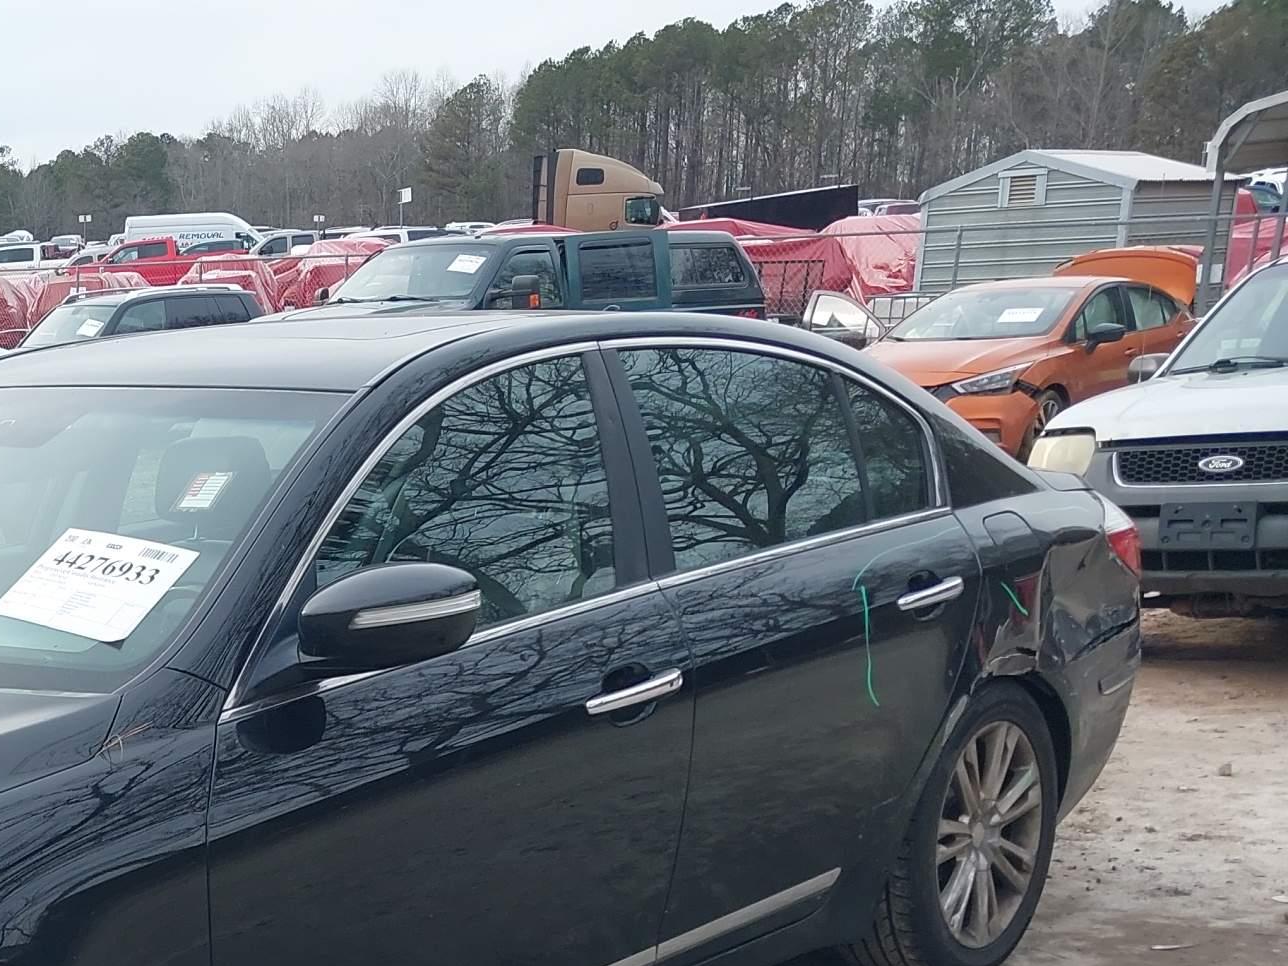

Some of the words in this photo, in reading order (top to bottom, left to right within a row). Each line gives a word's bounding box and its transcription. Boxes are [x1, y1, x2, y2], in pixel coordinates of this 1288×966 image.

[178, 231, 224, 240] REMOVAL
[1208, 459, 1233, 469] Ford
[53, 550, 161, 585] 44276933
